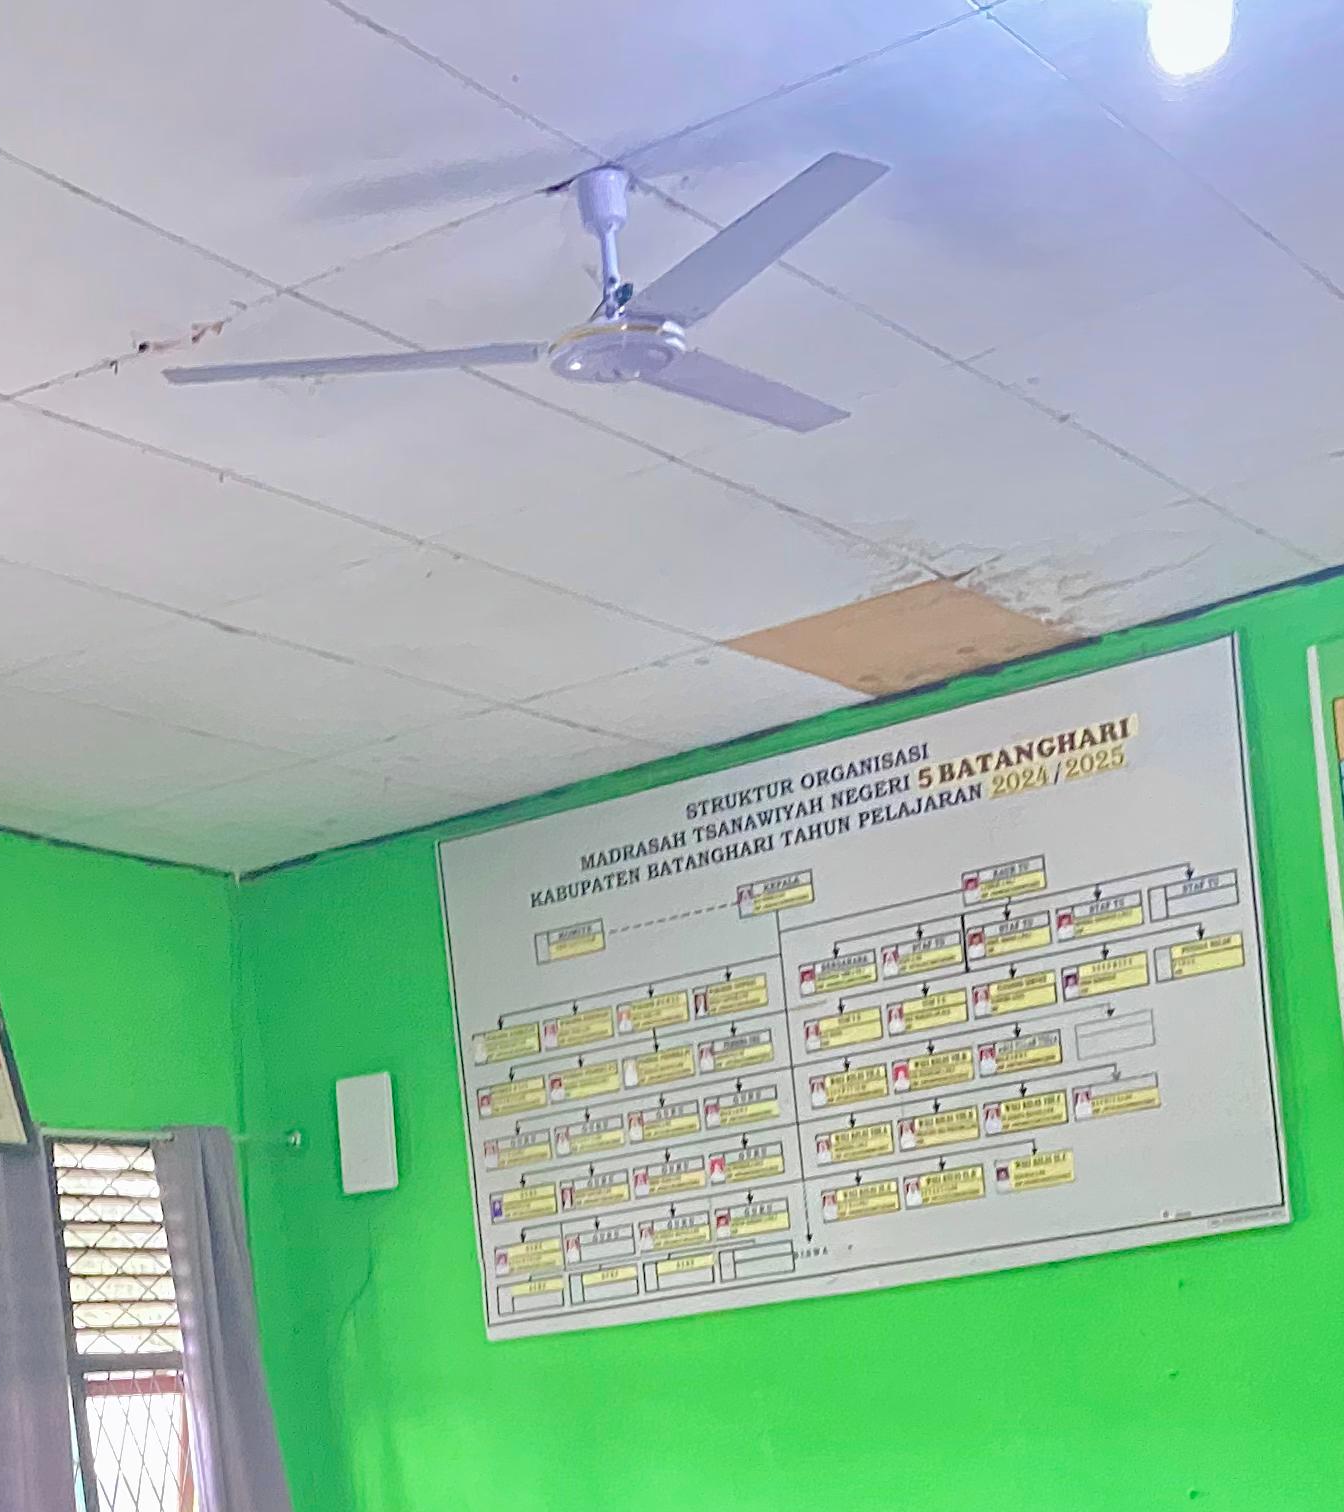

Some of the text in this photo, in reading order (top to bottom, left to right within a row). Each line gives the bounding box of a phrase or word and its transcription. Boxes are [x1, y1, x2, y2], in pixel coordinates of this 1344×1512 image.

[579, 717, 1131, 871] MADRASAH TSANAWIYAH NEGERI 5 BATANGHARI
[685, 742, 930, 821] STRUKTUR ORGANISASI
[529, 868, 640, 909] KABUPATEN
[647, 837, 775, 881] BATANGHARI
[781, 817, 851, 849] TAHUN
[858, 782, 982, 830] PELAJARAN
